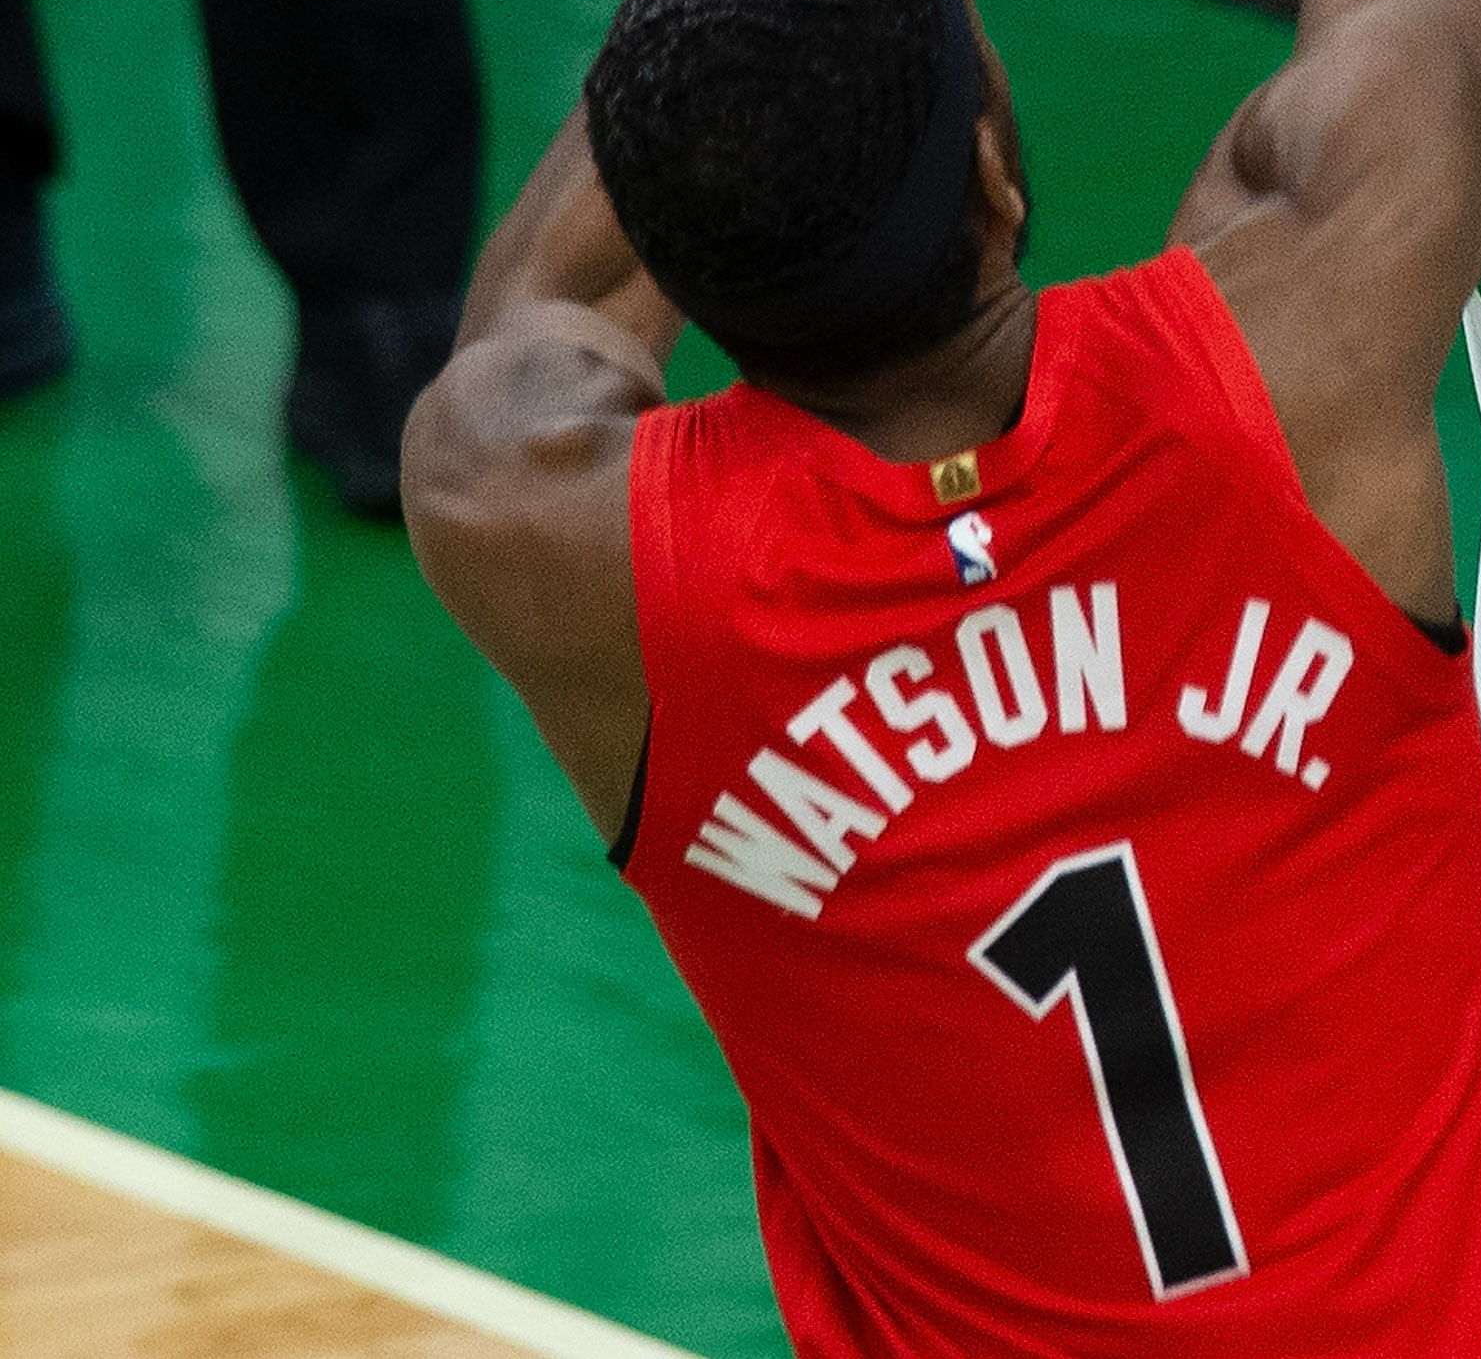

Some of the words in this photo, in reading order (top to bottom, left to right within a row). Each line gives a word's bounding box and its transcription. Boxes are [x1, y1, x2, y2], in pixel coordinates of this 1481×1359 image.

[682, 581, 1130, 922] WATSON
[1175, 596, 1355, 794] JR.
[966, 838, 1252, 1303] 1
